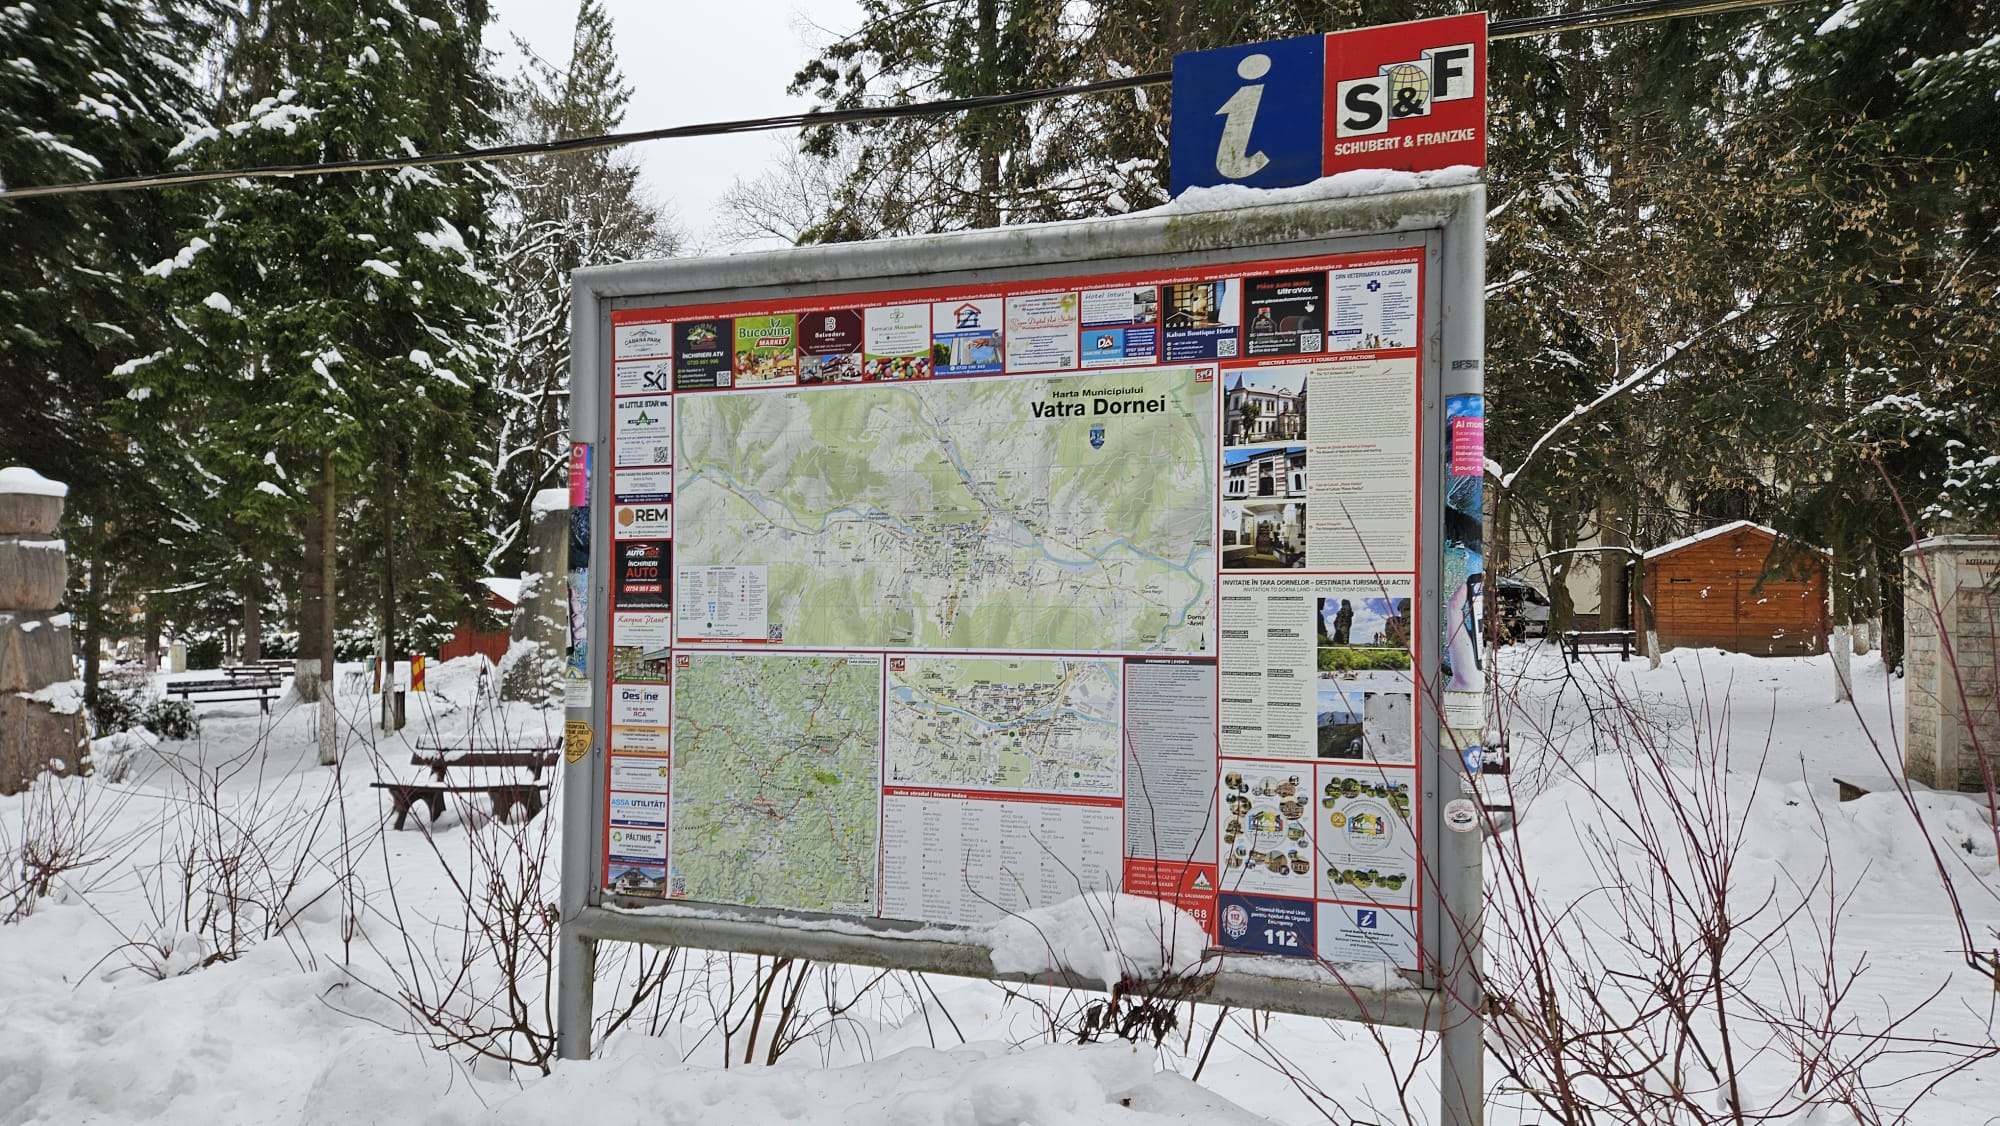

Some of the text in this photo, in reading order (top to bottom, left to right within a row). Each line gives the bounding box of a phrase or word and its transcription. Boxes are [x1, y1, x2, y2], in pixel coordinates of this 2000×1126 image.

[1334, 128, 1476, 156] SCHUBERT & FRANZKE
[739, 326, 791, 338] Bucovina
[1187, 329, 1216, 337] Boutique
[759, 338, 787, 346] MARKET
[1338, 354, 1376, 362] ATTRACTIONS
[1052, 386, 1144, 399] Harta Municipiului
[645, 400, 659, 408] STAR
[1031, 395, 1165, 418] Vatra Dornei
[635, 508, 668, 521] REM
[626, 567, 658, 578] AUTO
[631, 799, 665, 810] UTILITĂȚI
[625, 832, 652, 843] PĂLTINIȘ
[1263, 929, 1298, 947] 112
